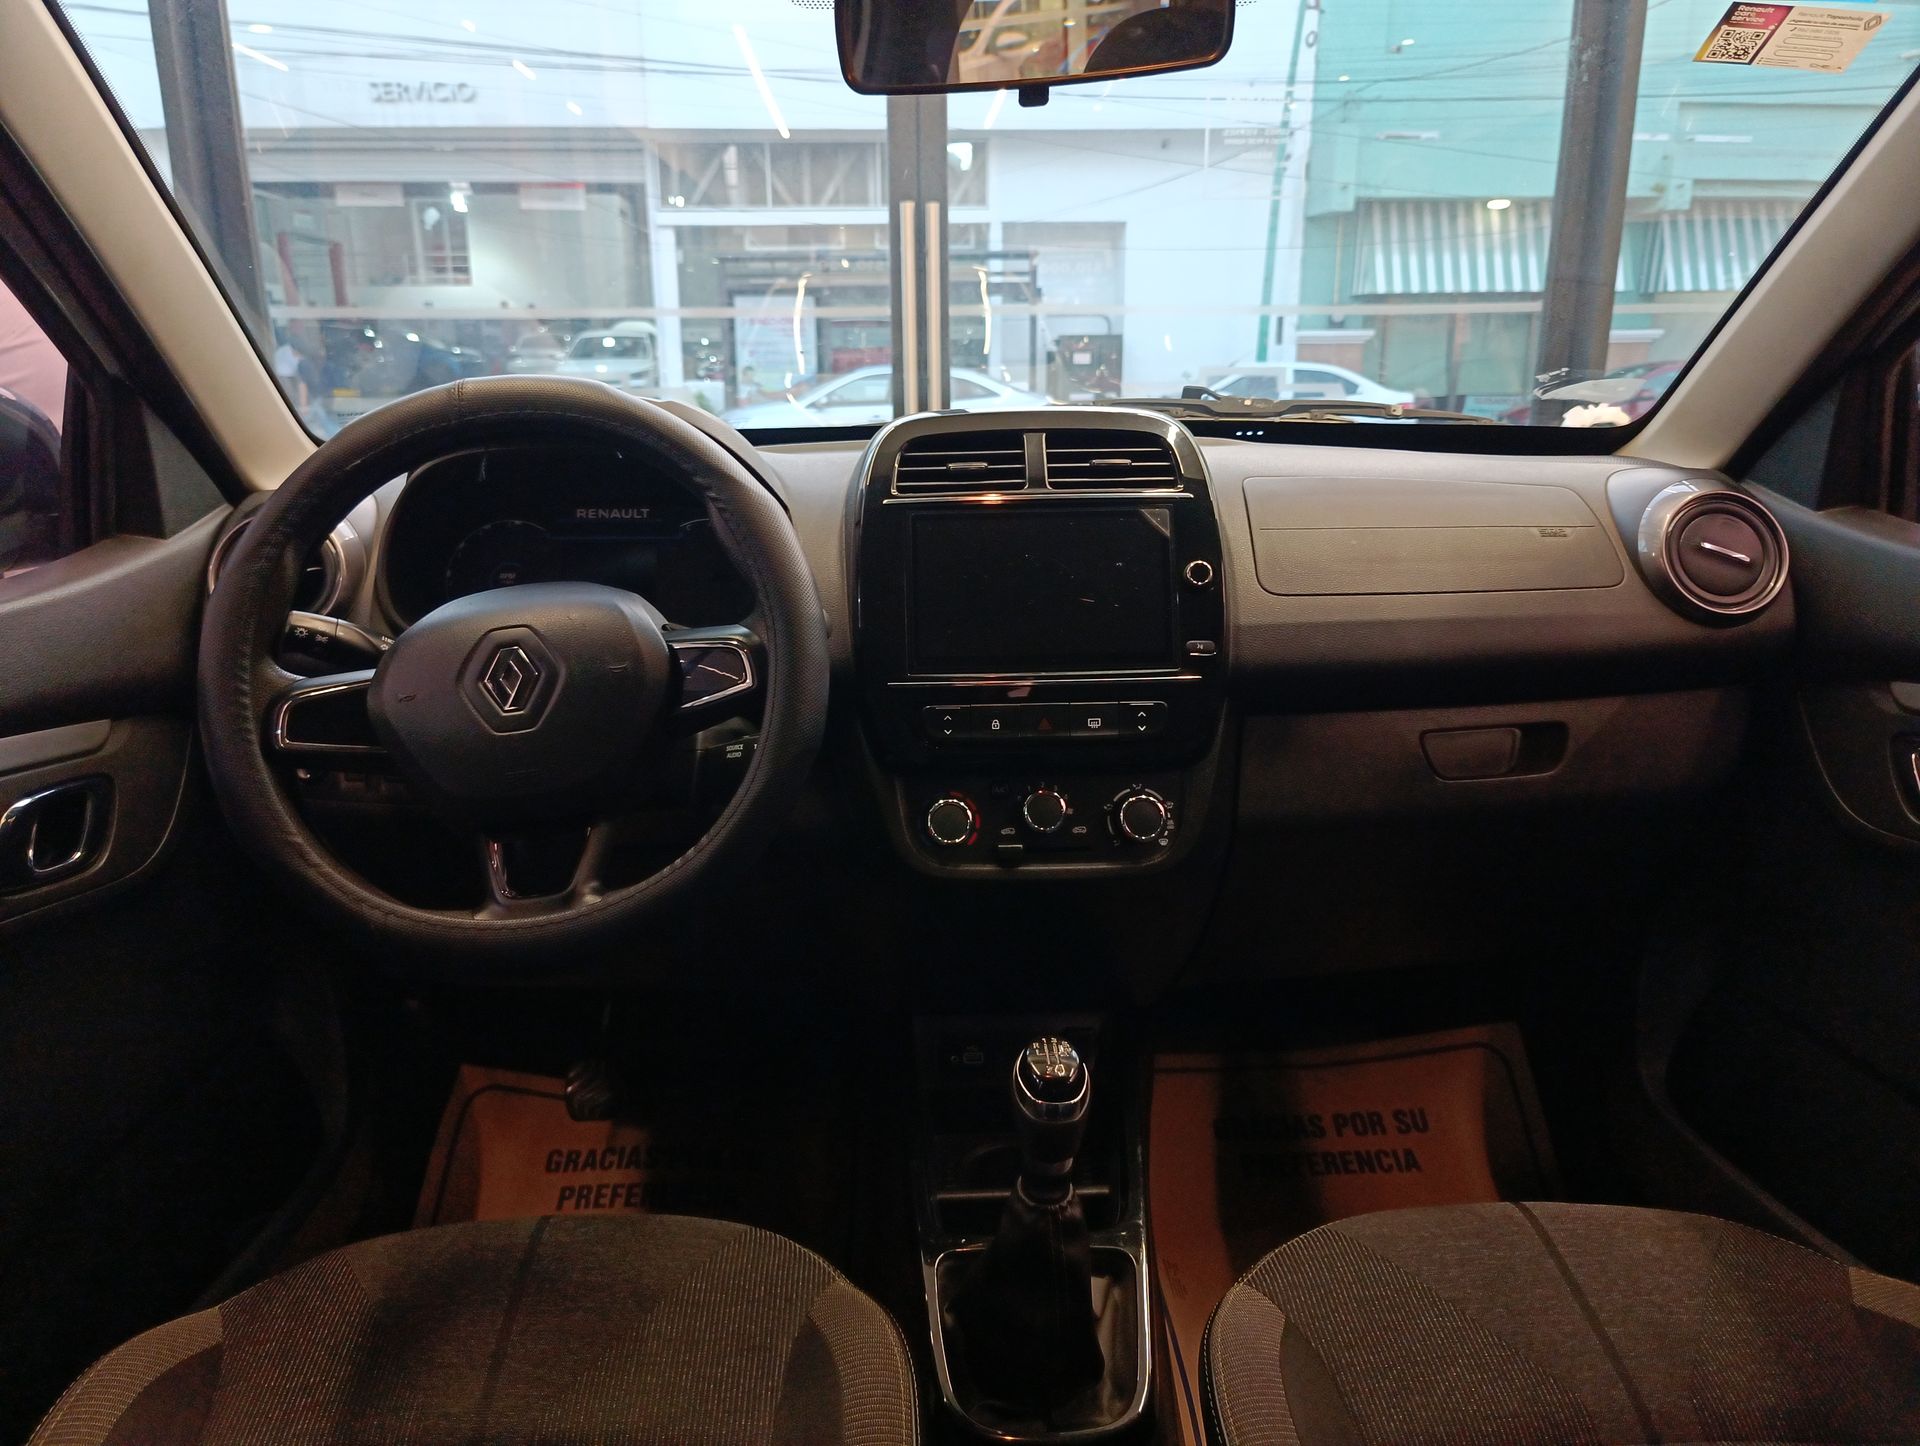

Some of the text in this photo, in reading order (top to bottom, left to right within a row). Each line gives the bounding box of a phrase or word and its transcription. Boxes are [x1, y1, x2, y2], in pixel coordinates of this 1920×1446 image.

[1737, 4, 1775, 13] Renault
[368, 81, 477, 103] SERVICIO
[576, 508, 650, 519] RENAULT
[1333, 1113, 1387, 1137] POR
[1393, 1108, 1429, 1134] SU
